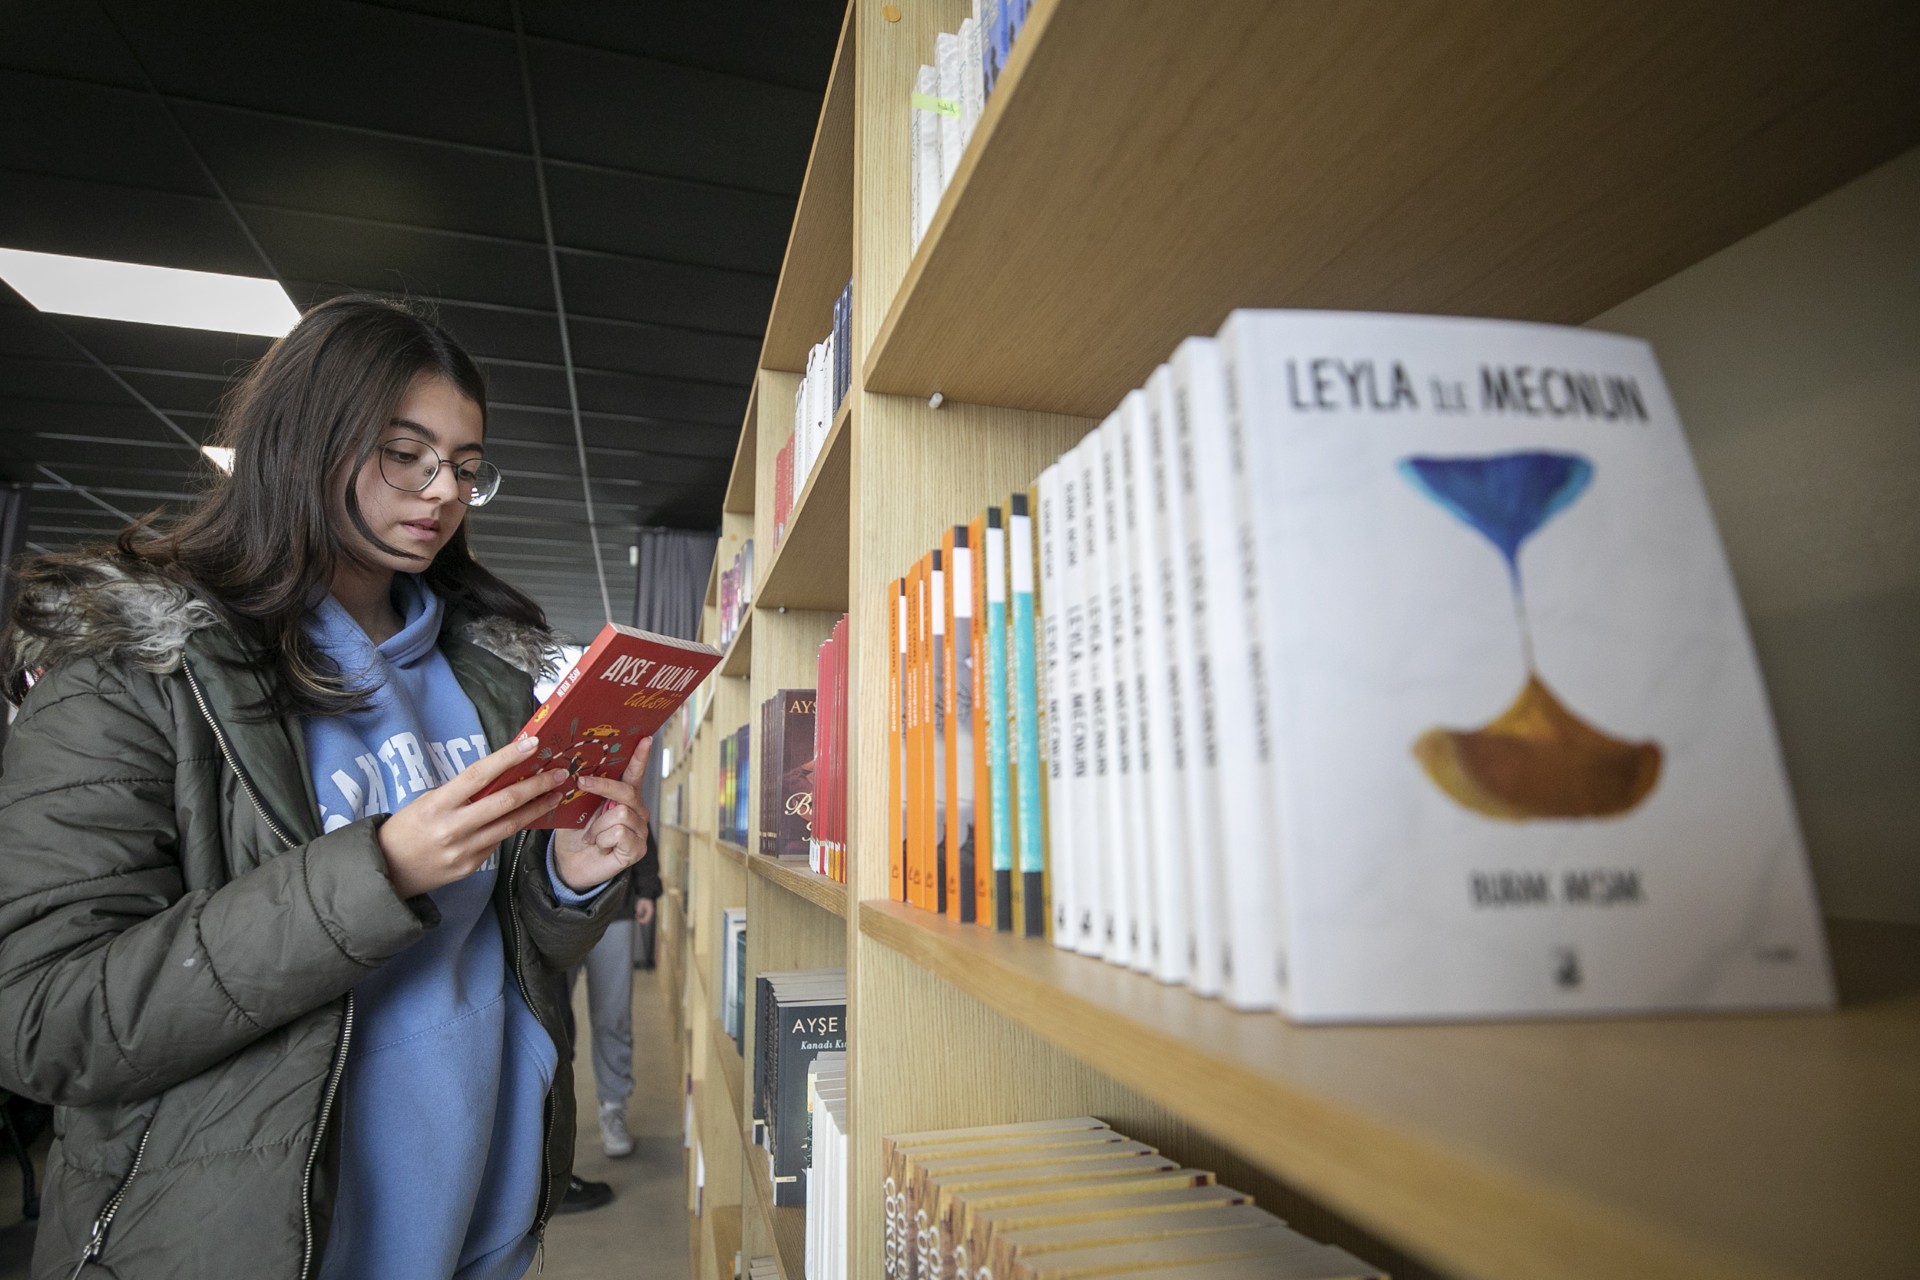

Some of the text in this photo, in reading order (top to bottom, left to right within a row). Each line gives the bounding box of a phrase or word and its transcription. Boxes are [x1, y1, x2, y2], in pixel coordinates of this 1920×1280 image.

[1285, 357, 1419, 413] LEYLA
[600, 655, 699, 692] AYŞE KULİN
[792, 1017, 838, 1036] AYŞE
[801, 1040, 832, 1050] Kanadı
